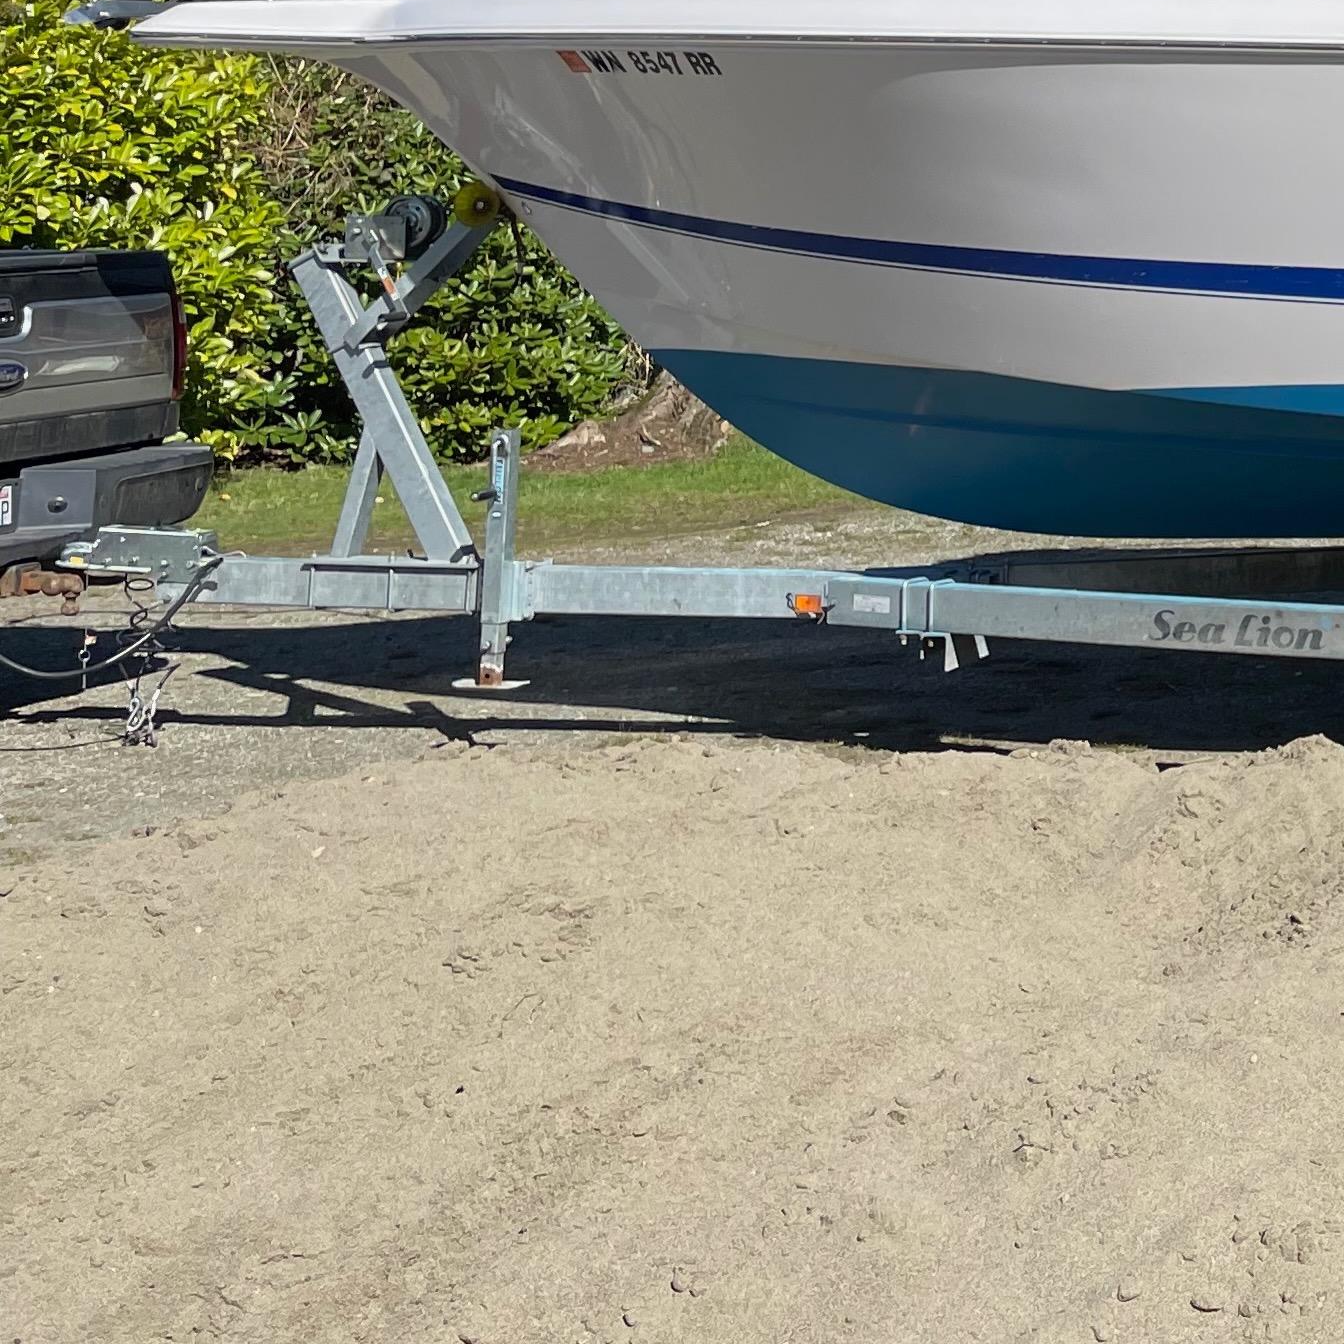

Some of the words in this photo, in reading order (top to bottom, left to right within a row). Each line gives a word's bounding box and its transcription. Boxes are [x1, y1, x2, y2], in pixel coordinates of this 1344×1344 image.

[581, 50, 627, 73] WN
[627, 51, 684, 75] 8547
[683, 51, 723, 75] RR
[1148, 609, 1227, 645] Sea
[1234, 614, 1326, 650] Lion
